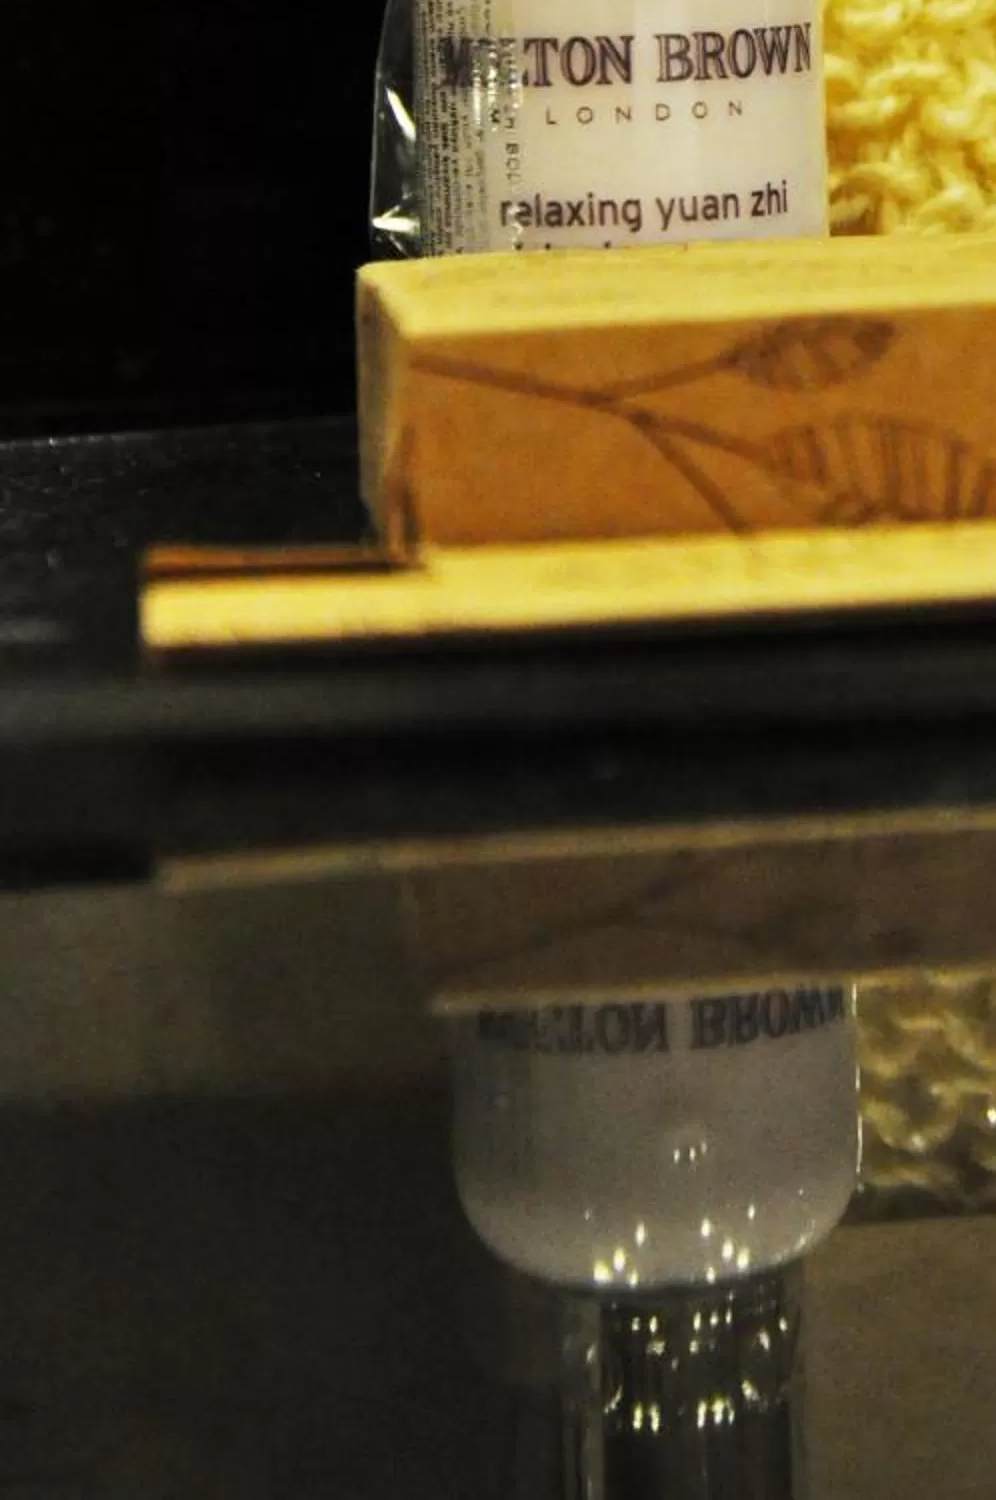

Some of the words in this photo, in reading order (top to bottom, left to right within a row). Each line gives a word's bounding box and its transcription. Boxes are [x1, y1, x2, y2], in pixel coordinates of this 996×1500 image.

[654, 21, 813, 84] BROWN
[545, 101, 744, 126] LONDON
[499, 192, 643, 233] relaxing
[655, 191, 740, 231] yuan
[750, 179, 789, 218] zhi
